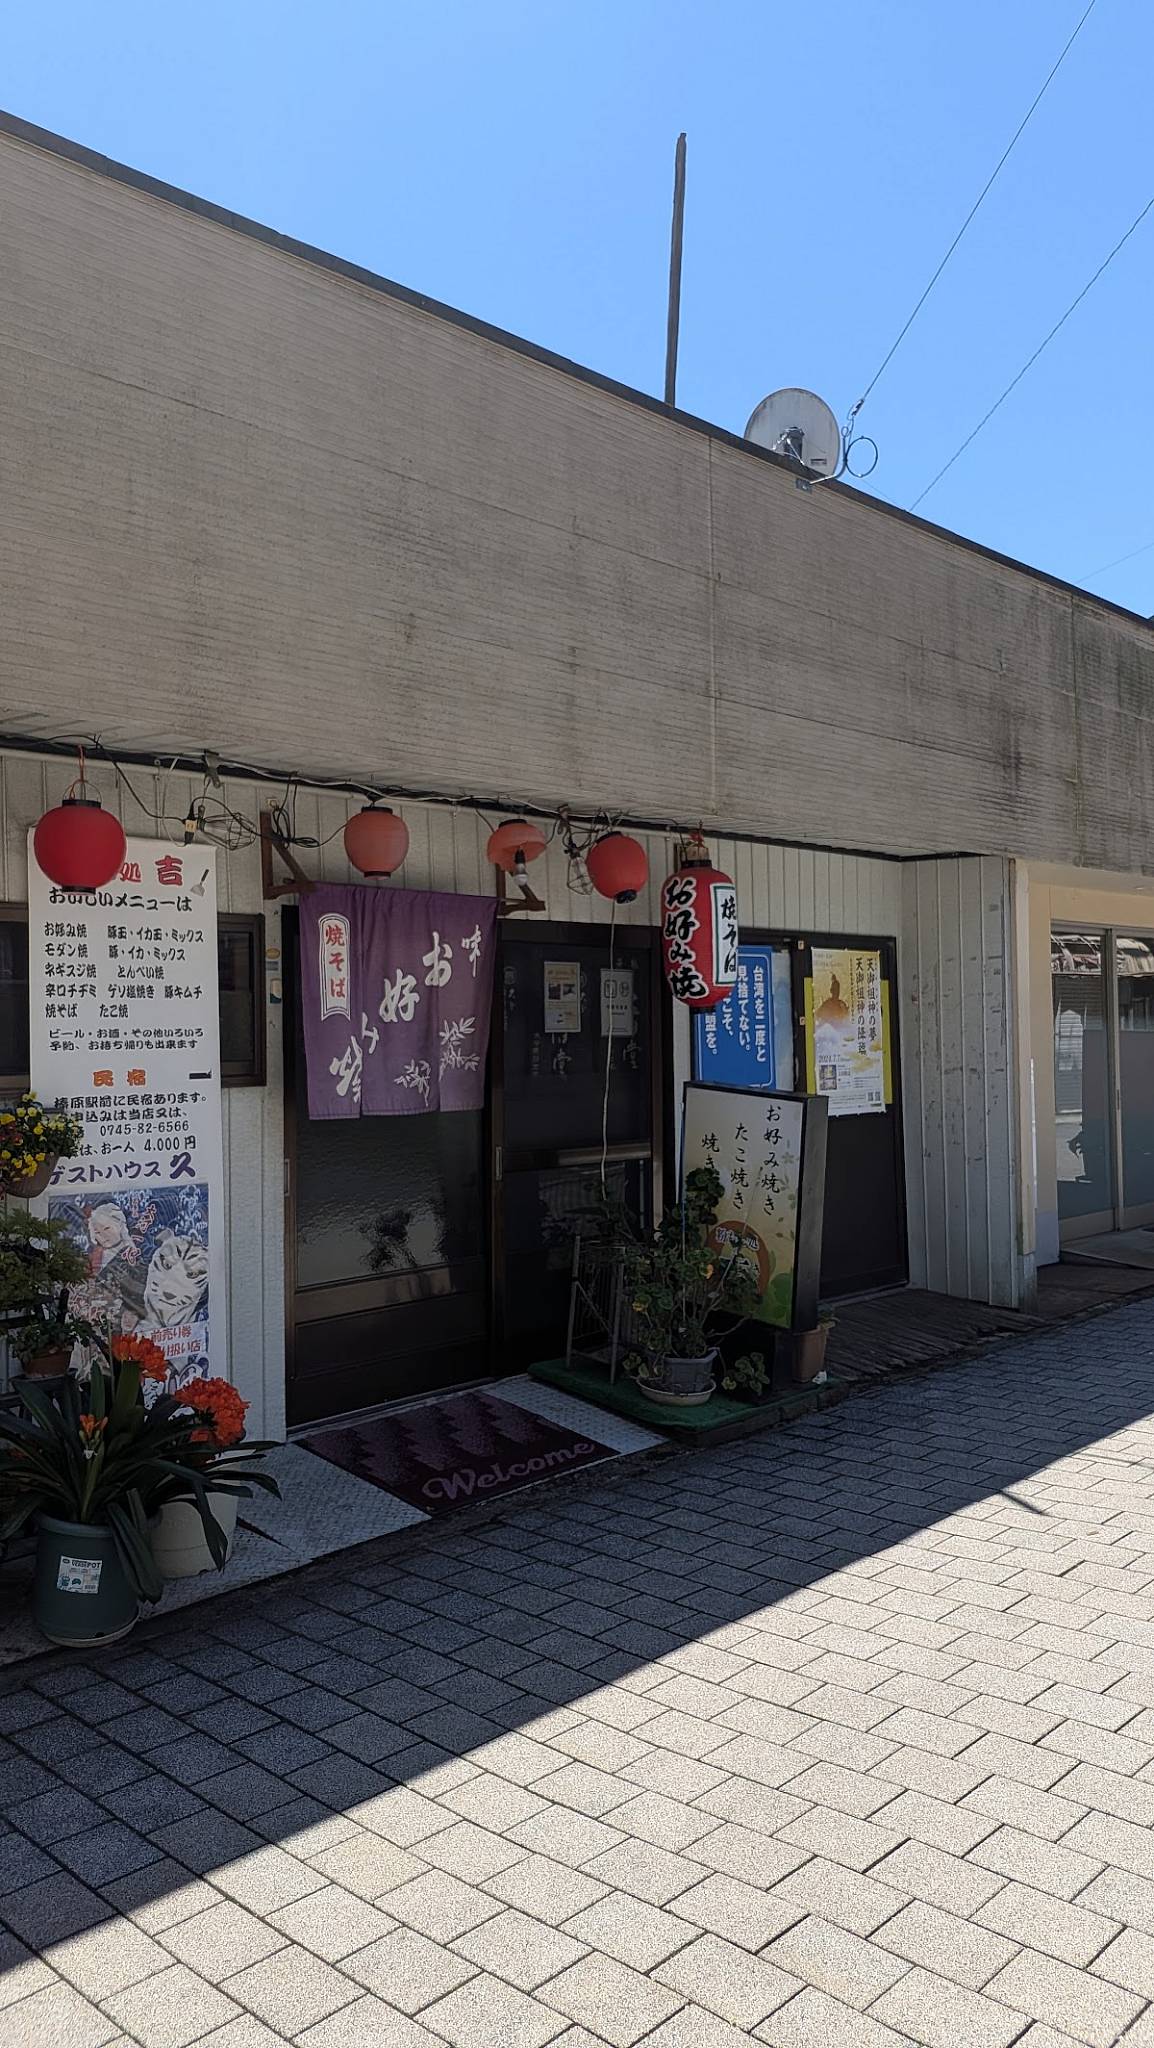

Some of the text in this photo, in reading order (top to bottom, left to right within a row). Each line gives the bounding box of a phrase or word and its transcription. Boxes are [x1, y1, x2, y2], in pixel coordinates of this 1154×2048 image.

[155, 855, 183, 886] 吉
[44, 922, 87, 937] お好み焼
[663, 877, 708, 998] お好み焼
[45, 943, 88, 958] モダン焼
[326, 925, 345, 998] 焼そば
[461, 924, 481, 978] 味
[45, 963, 97, 978] ネギスジ焼
[45, 983, 97, 997] 辛口チヂミ
[165, 985, 202, 999] 豚キムチ
[45, 1003, 128, 1019] 焼そば たこ焼
[722, 991, 734, 1036] こそ、
[737, 965, 751, 1051] 見捨てない。
[753, 965, 767, 1062] 台湾を二度と
[93, 1069, 146, 1087] 民宿
[54, 1092, 207, 1109] 榛原駅前に民宿あります。
[63, 1108, 187, 1122] 申込みは当店又は、
[100, 1121, 189, 1136] 0745-82-6566
[170, 1152, 195, 1179] 久
[731, 1123, 749, 1209] たこ焼き
[762, 1104, 782, 1215] お好み焼き
[422, 1441, 594, 1500] Welcome
